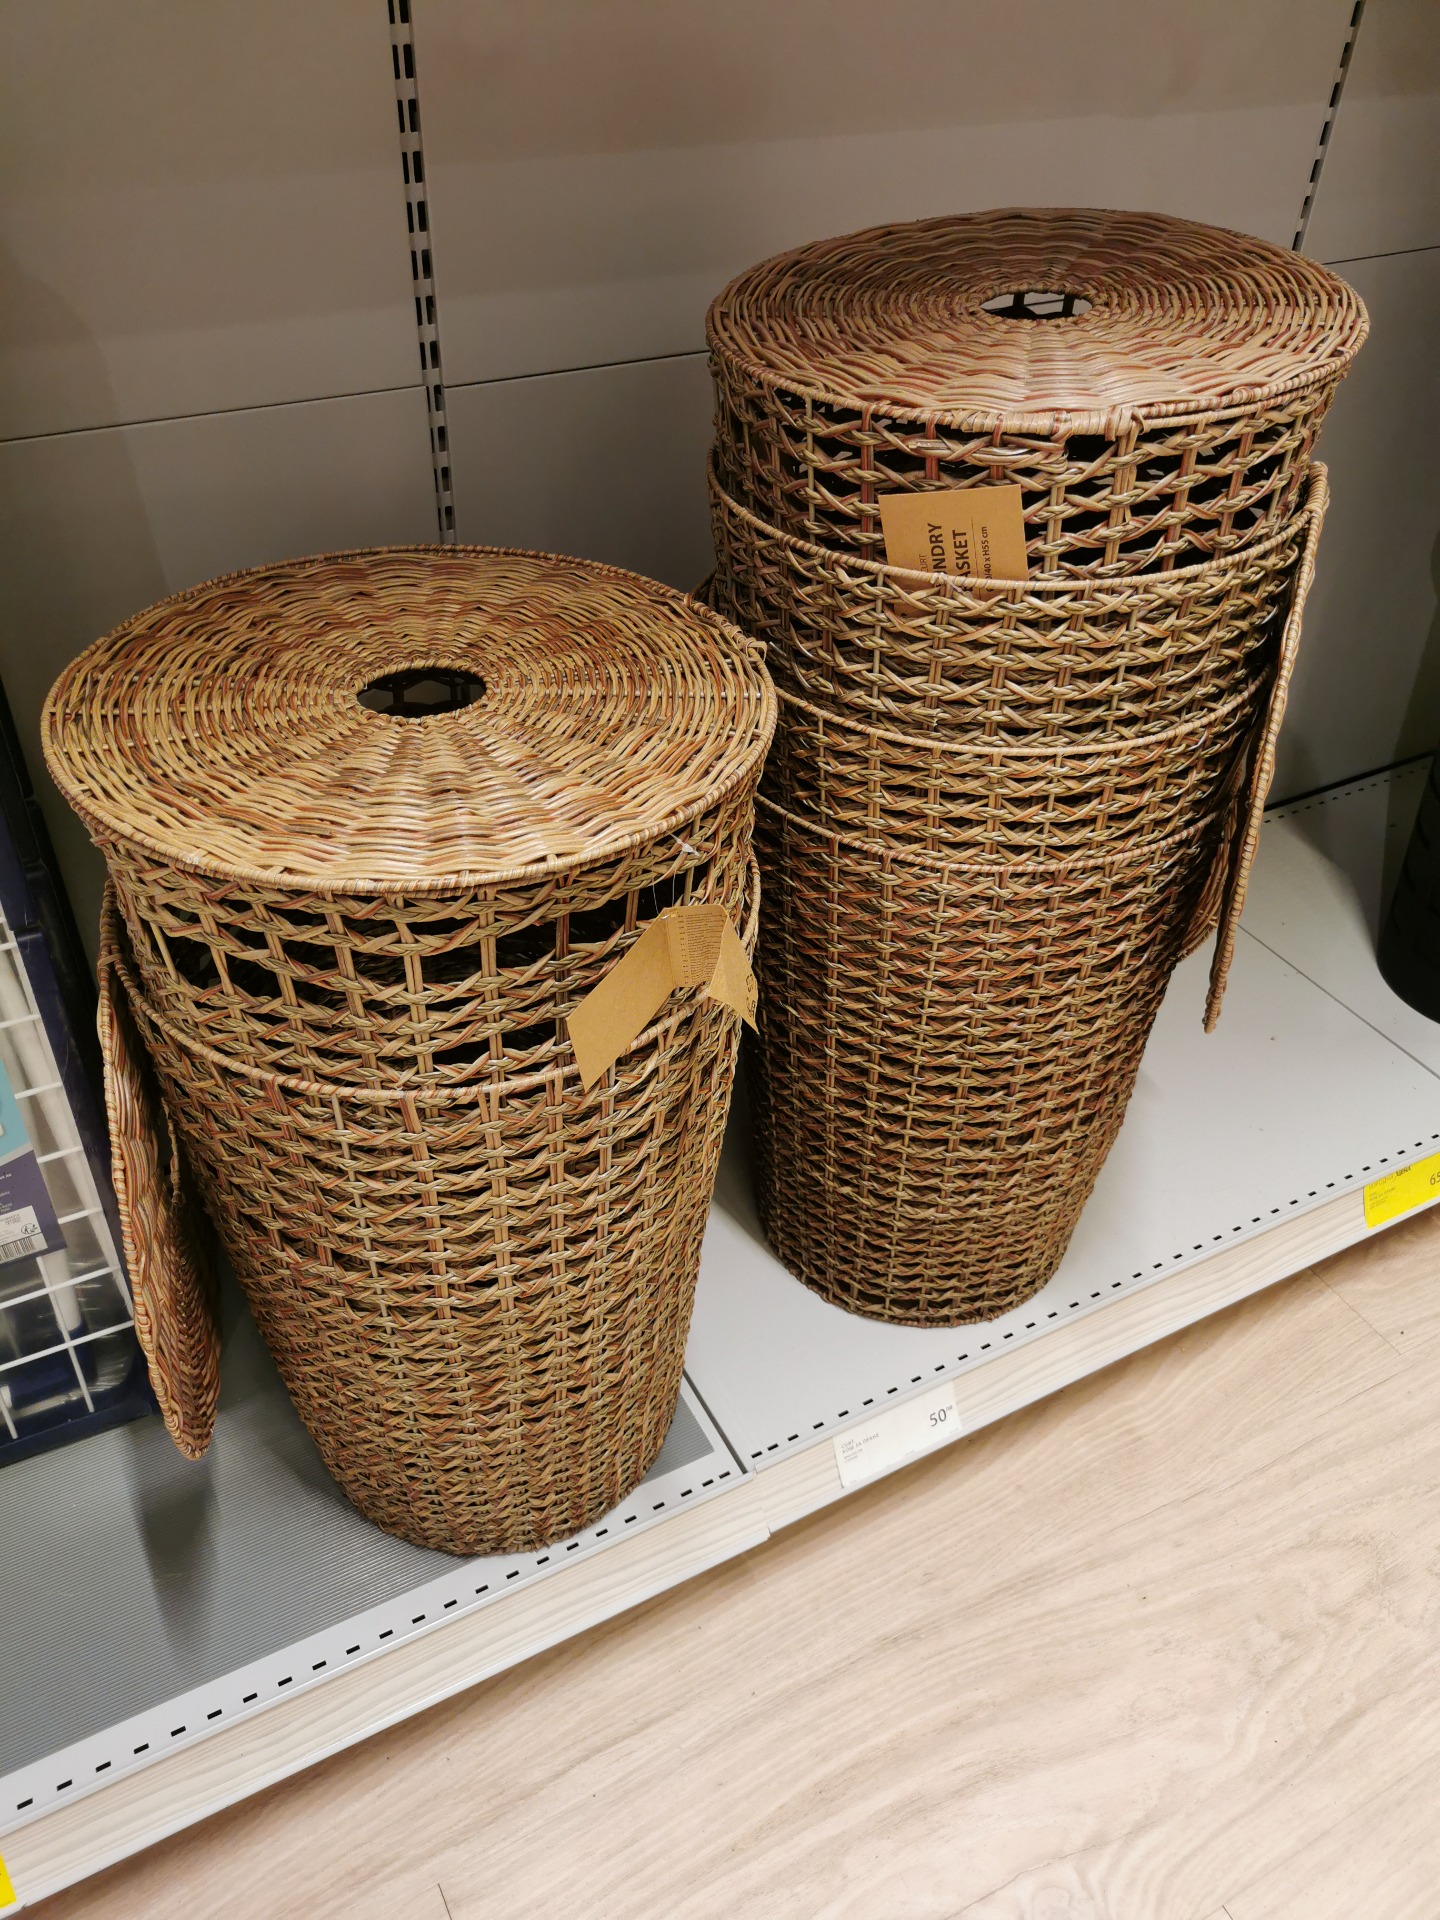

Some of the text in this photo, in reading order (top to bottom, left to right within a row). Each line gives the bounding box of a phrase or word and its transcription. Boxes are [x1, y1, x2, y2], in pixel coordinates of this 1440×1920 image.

[981, 526, 988, 539] cm
[981, 539, 991, 557] H55
[929, 1408, 947, 1427] 50
